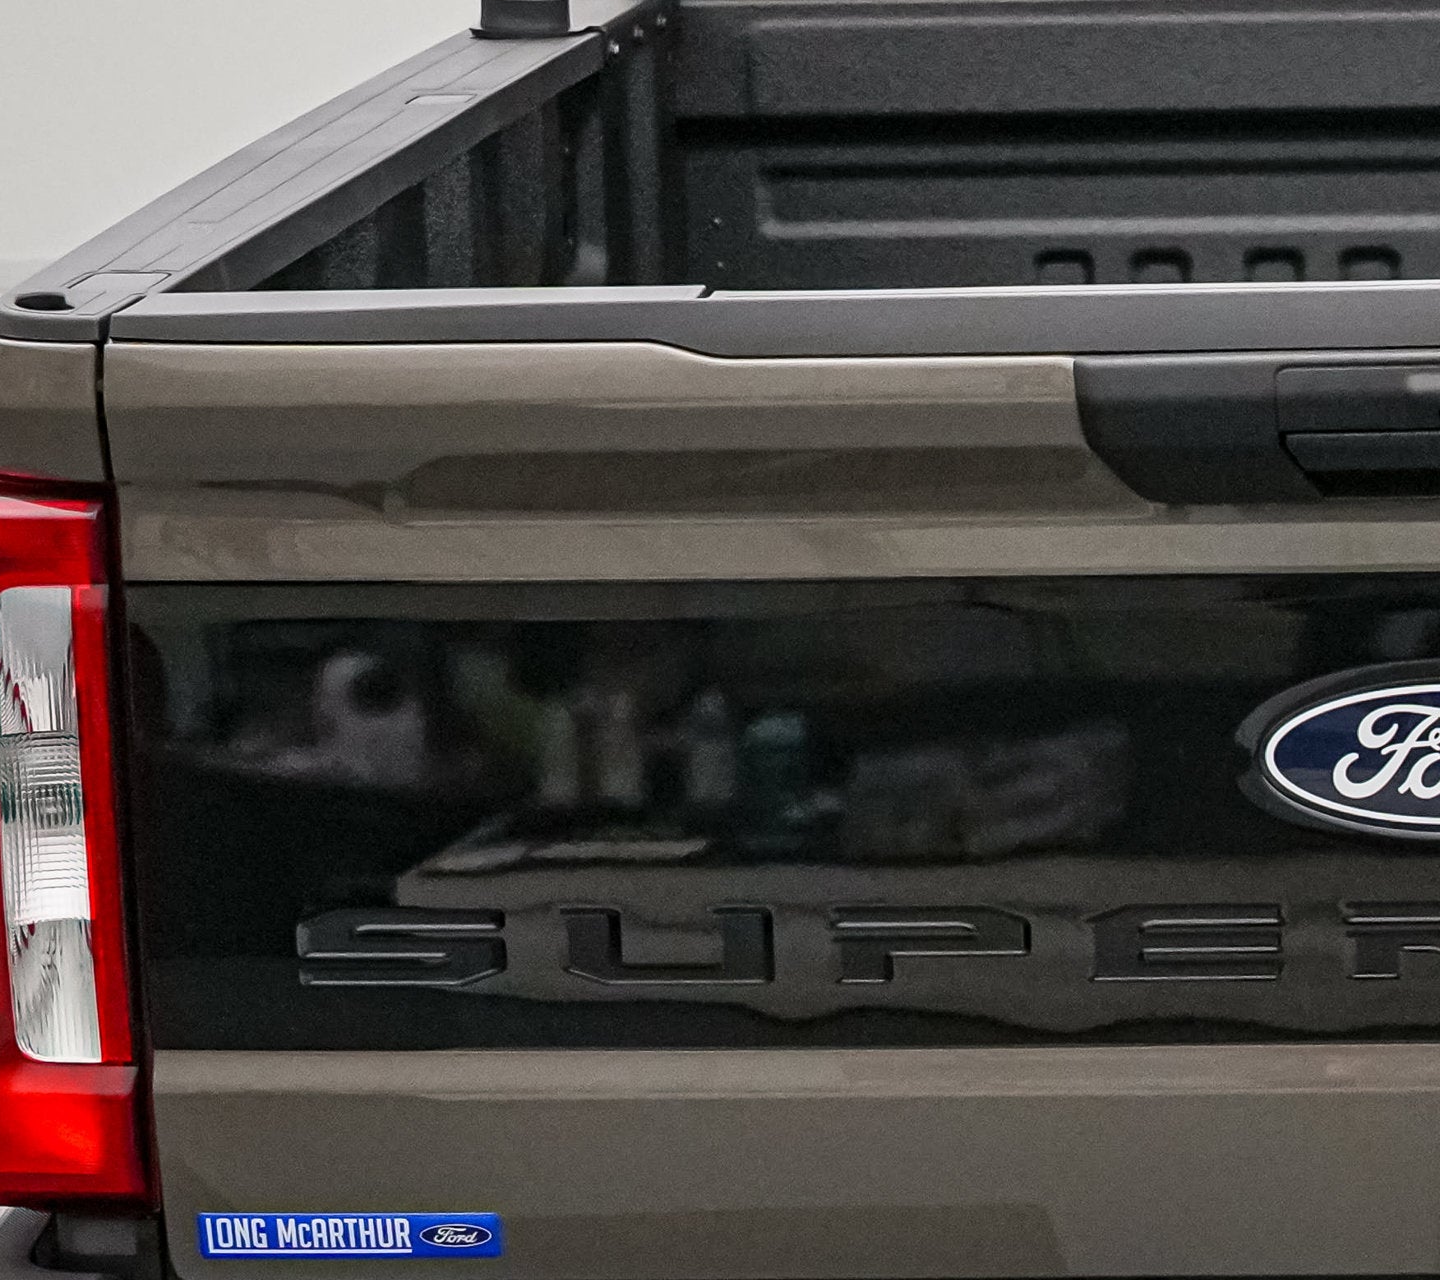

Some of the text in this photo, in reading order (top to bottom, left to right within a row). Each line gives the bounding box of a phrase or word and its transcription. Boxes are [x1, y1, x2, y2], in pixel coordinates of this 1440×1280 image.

[205, 1217, 412, 1253] LONG McARTHUR
[433, 1227, 478, 1245] Ford
